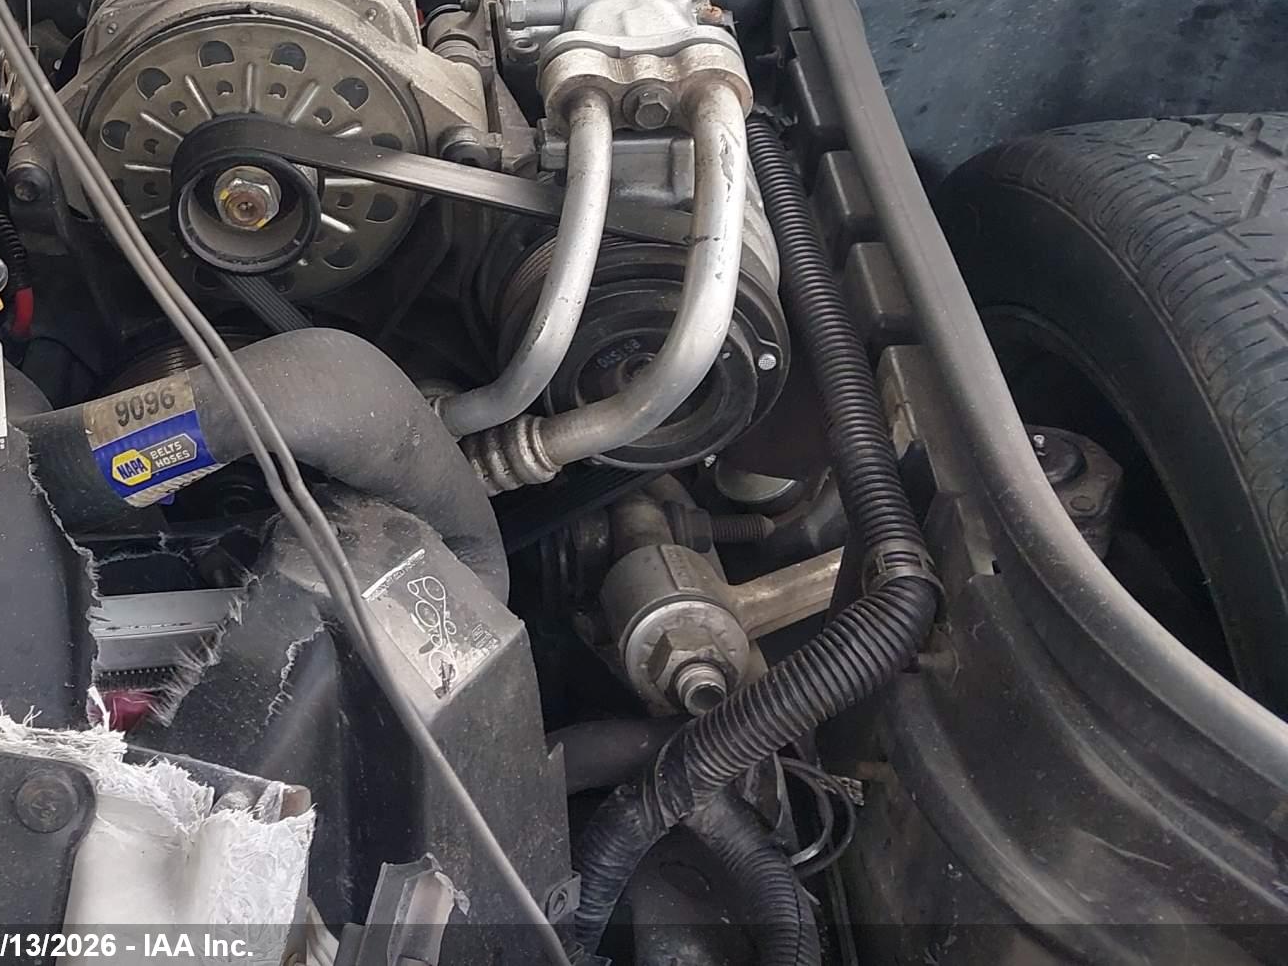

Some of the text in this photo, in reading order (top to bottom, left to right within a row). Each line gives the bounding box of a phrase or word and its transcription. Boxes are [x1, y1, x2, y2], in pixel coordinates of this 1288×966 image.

[150, 441, 182, 460] BELTS
[155, 450, 190, 468] HOSES
[116, 457, 148, 480] NAPA
